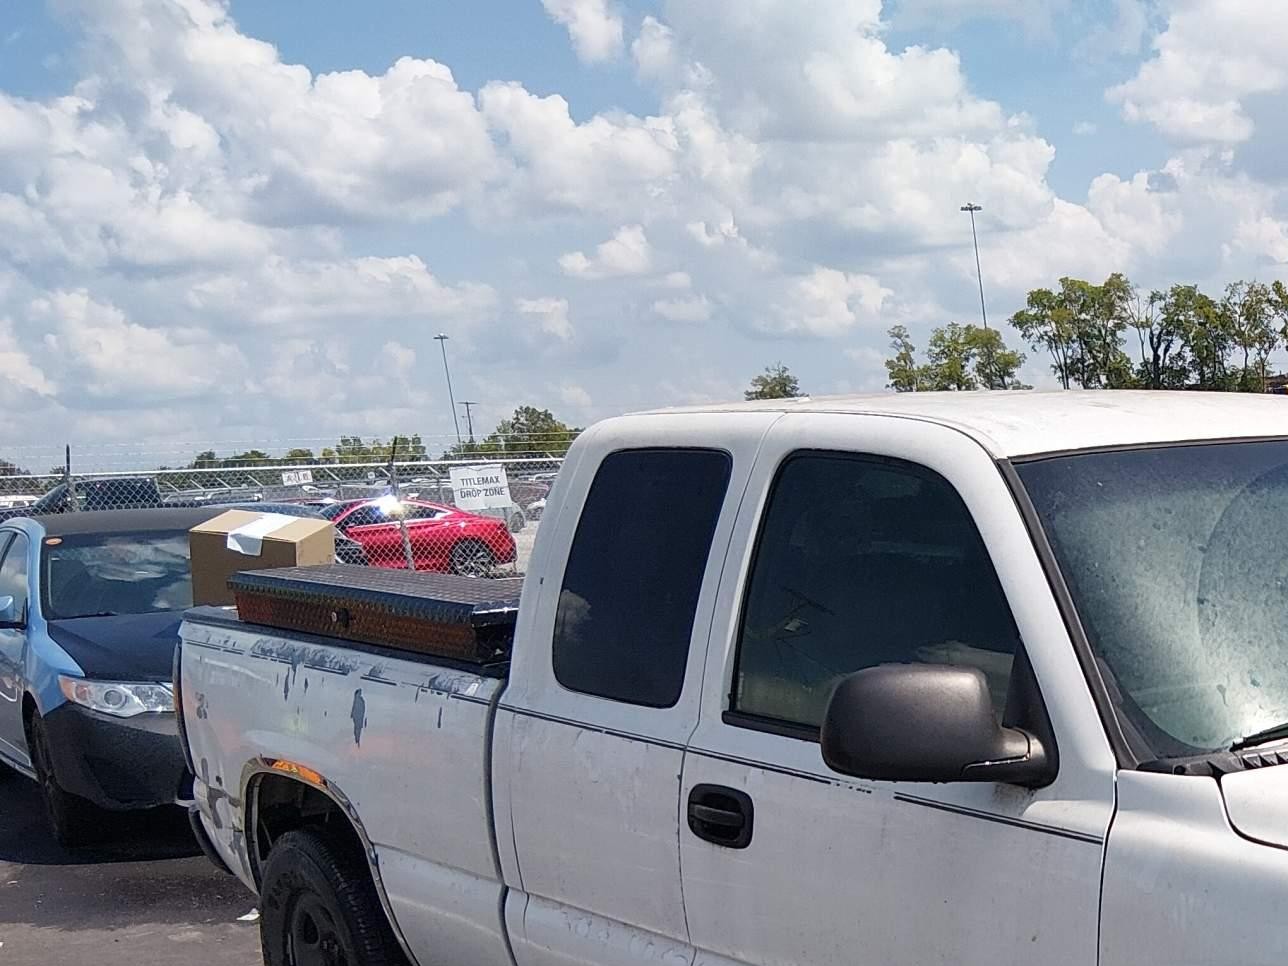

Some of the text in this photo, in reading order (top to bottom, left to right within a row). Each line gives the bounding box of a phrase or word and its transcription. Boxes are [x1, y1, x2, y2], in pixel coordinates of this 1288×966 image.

[460, 476, 500, 486] TITLEMAX
[460, 487, 505, 498] DROP ZONE
